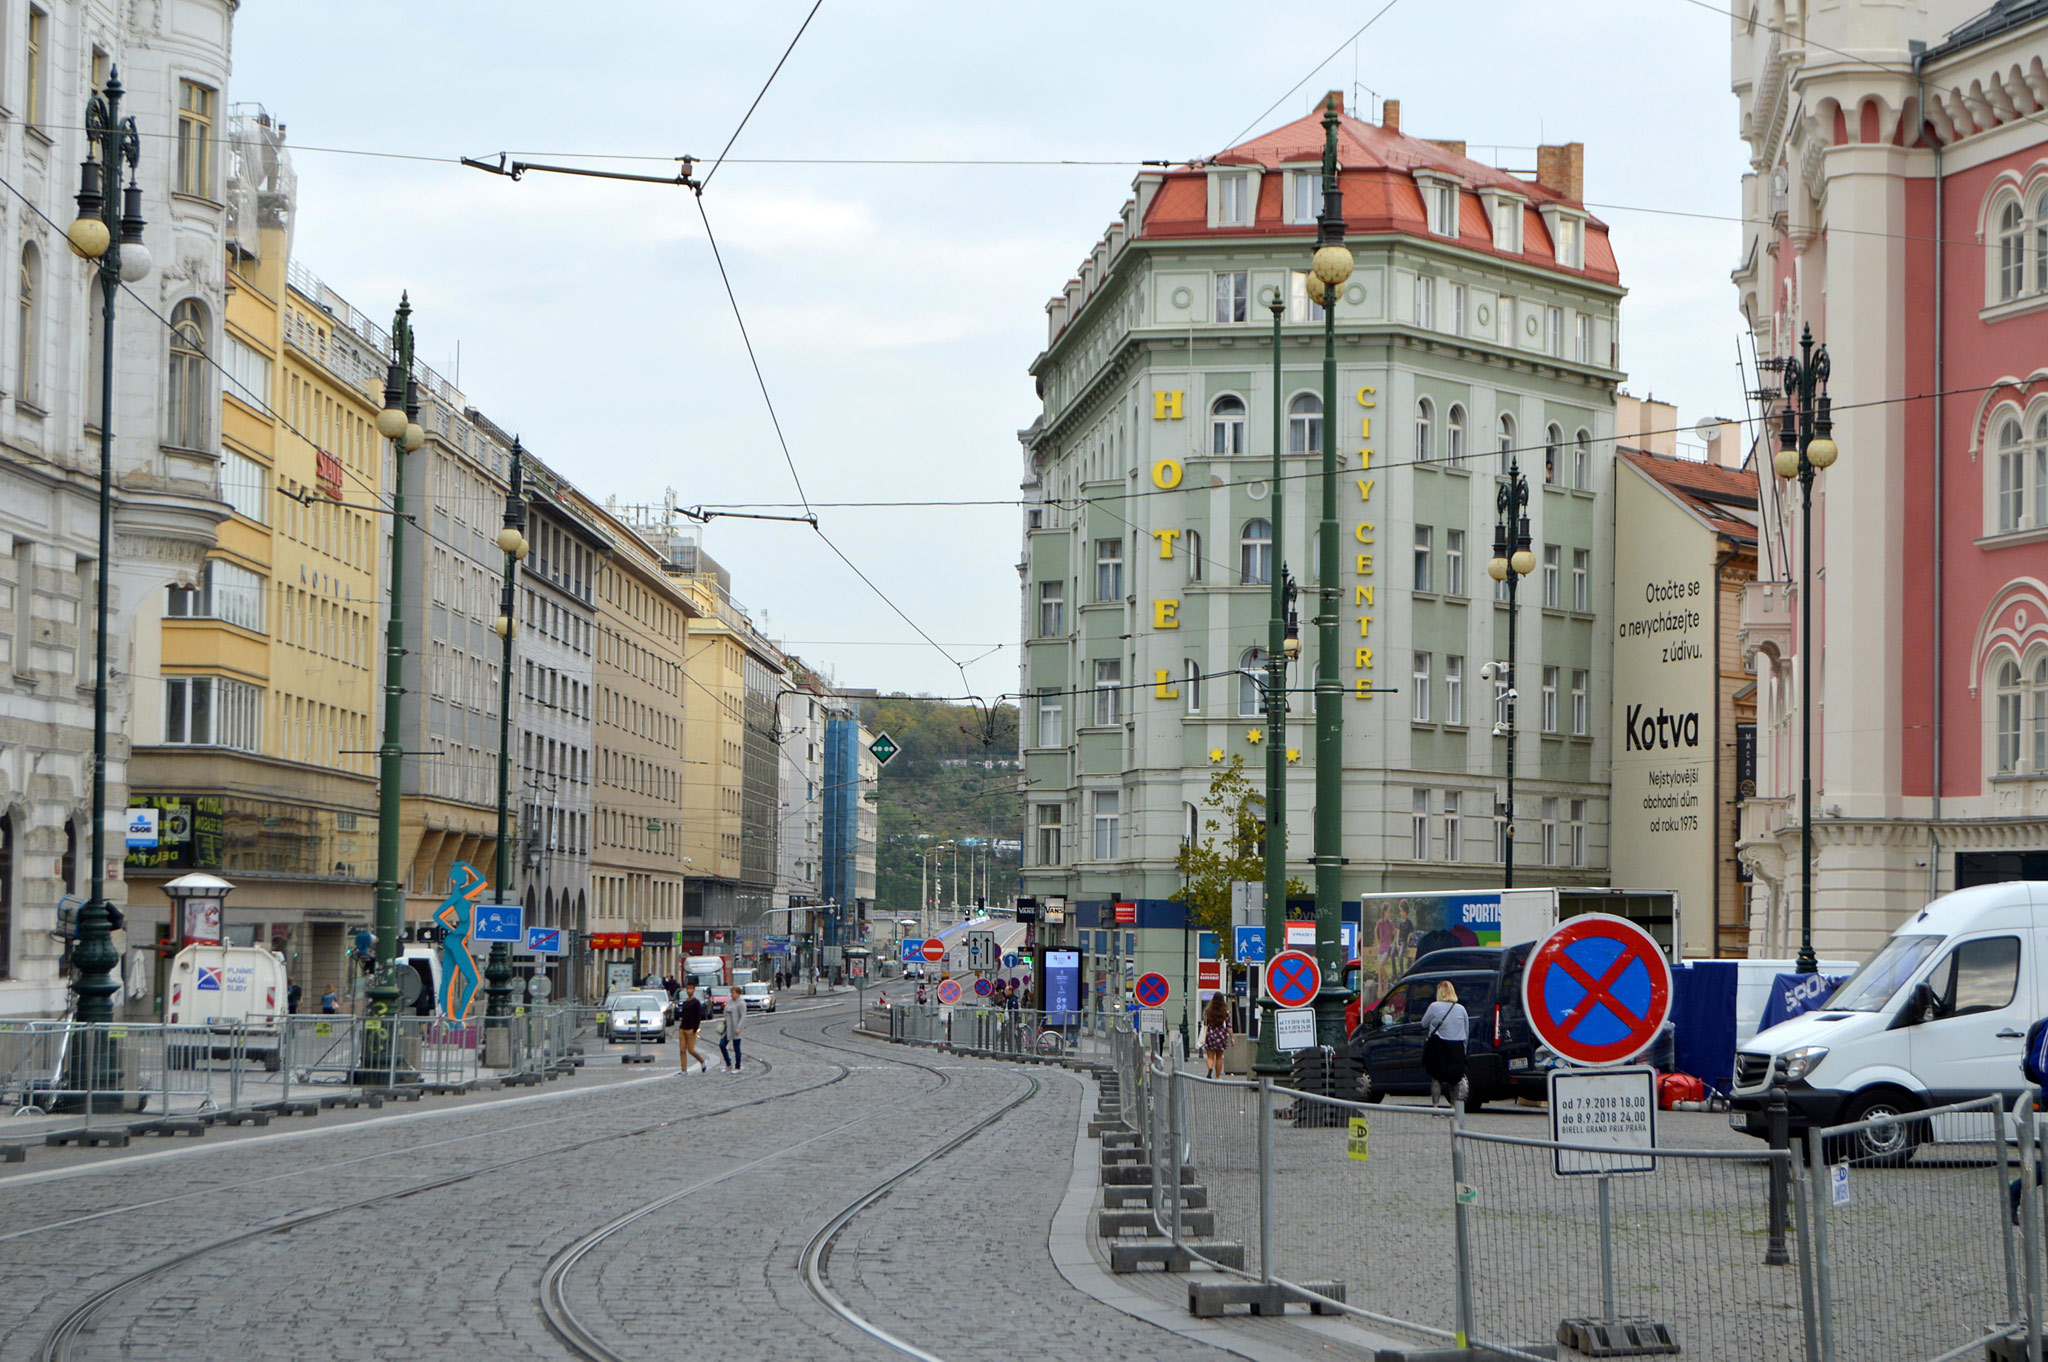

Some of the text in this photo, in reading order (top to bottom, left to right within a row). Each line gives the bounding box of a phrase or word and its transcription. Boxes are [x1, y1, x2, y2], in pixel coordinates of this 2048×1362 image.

[1152, 389, 1185, 700] HOTEL
[1354, 386, 1376, 701] CITY CENTRE
[301, 564, 350, 602] KOTVA
[1646, 580, 1700, 603] Otočte se
[1619, 608, 1700, 638] a nevycházejte
[1662, 640, 1702, 663] z údivu.
[1626, 703, 1698, 751] Kotva
[1648, 768, 1699, 788] Nejstylovější
[1643, 790, 1698, 809] obchodní dům
[1650, 815, 1698, 832] od roku 1975
[1018, 906, 1035, 914] VANS
[1044, 905, 1064, 914] VANS
[1562, 1096, 1645, 1109] od 7.9.2018 18.00
[1562, 1110, 1646, 1124] do 8.9.2018 24.00
[1561, 1123, 1647, 1134] BIRELL GRAND PRIX PRAHA
